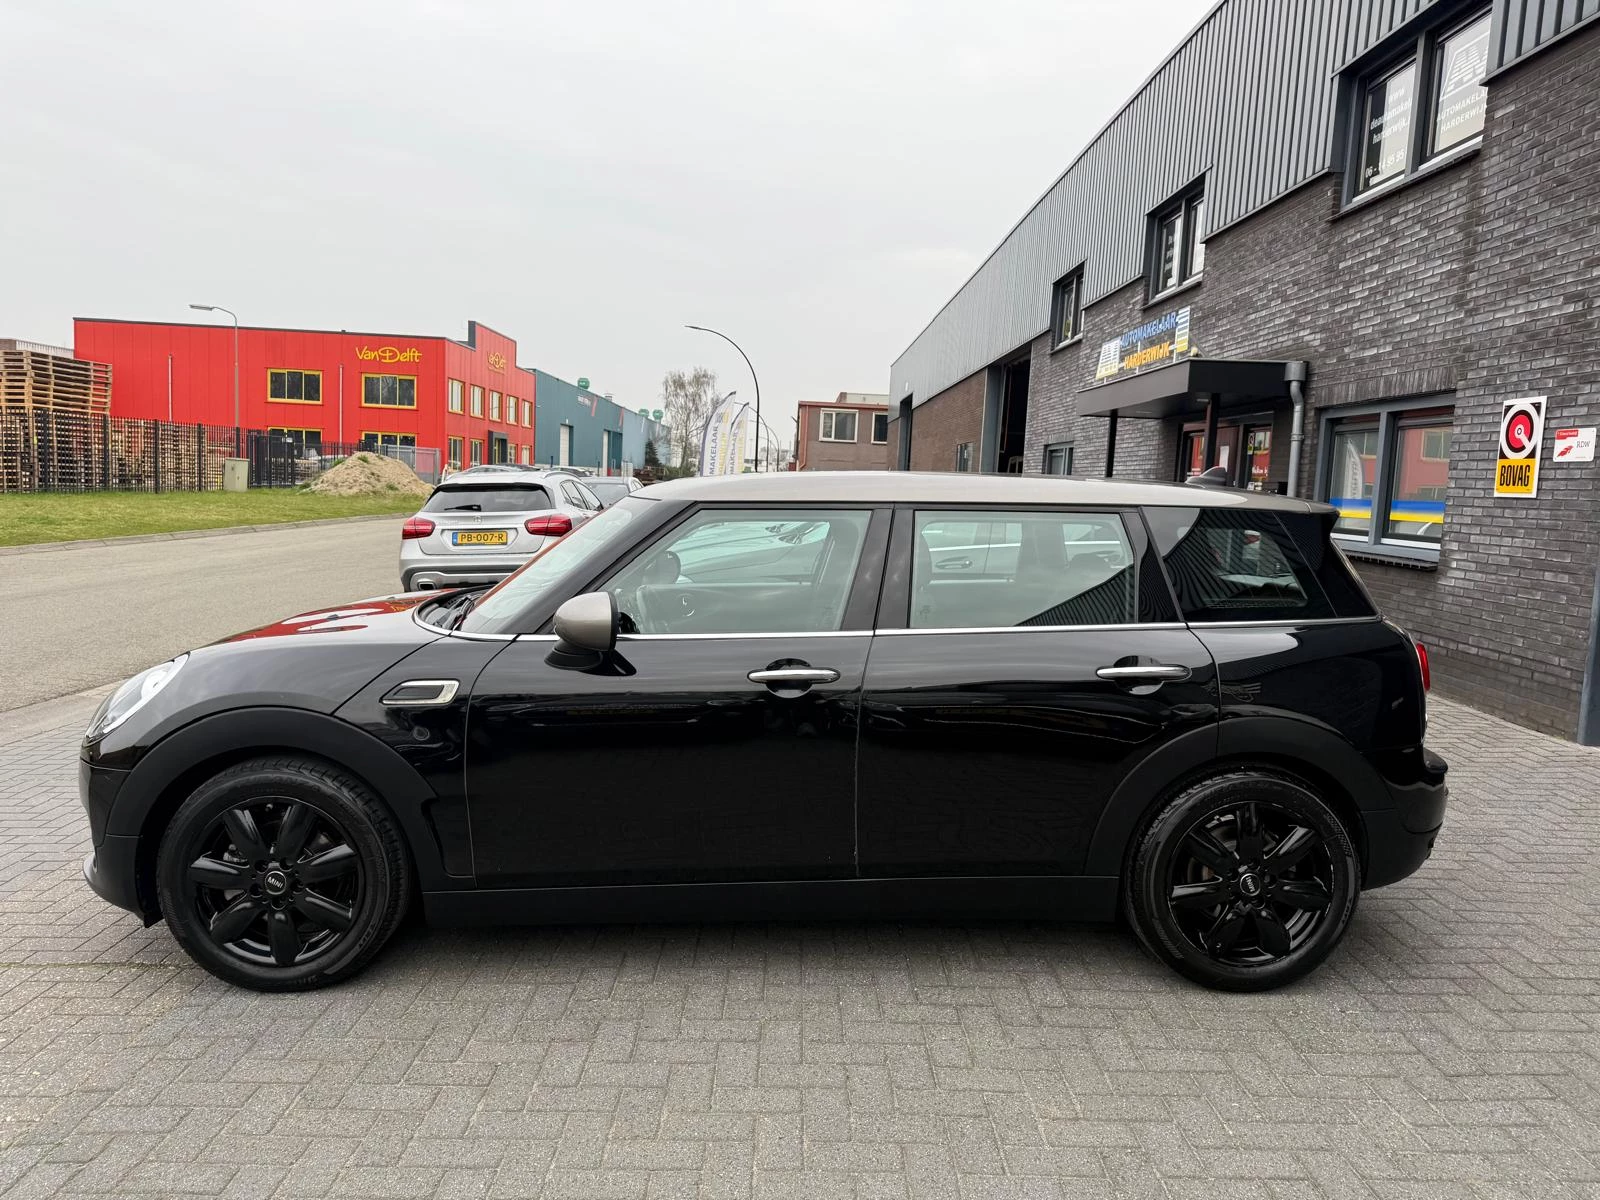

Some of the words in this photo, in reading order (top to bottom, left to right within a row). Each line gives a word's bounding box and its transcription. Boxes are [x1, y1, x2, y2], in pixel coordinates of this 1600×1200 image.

[1120, 311, 1177, 348] AUTOMAKELAAR
[355, 346, 379, 361] Van
[378, 347, 422, 363] Delft
[1124, 341, 1171, 370] HARDERWIJK
[1499, 464, 1531, 487] BOVAG
[460, 533, 504, 542] PB-007-R
